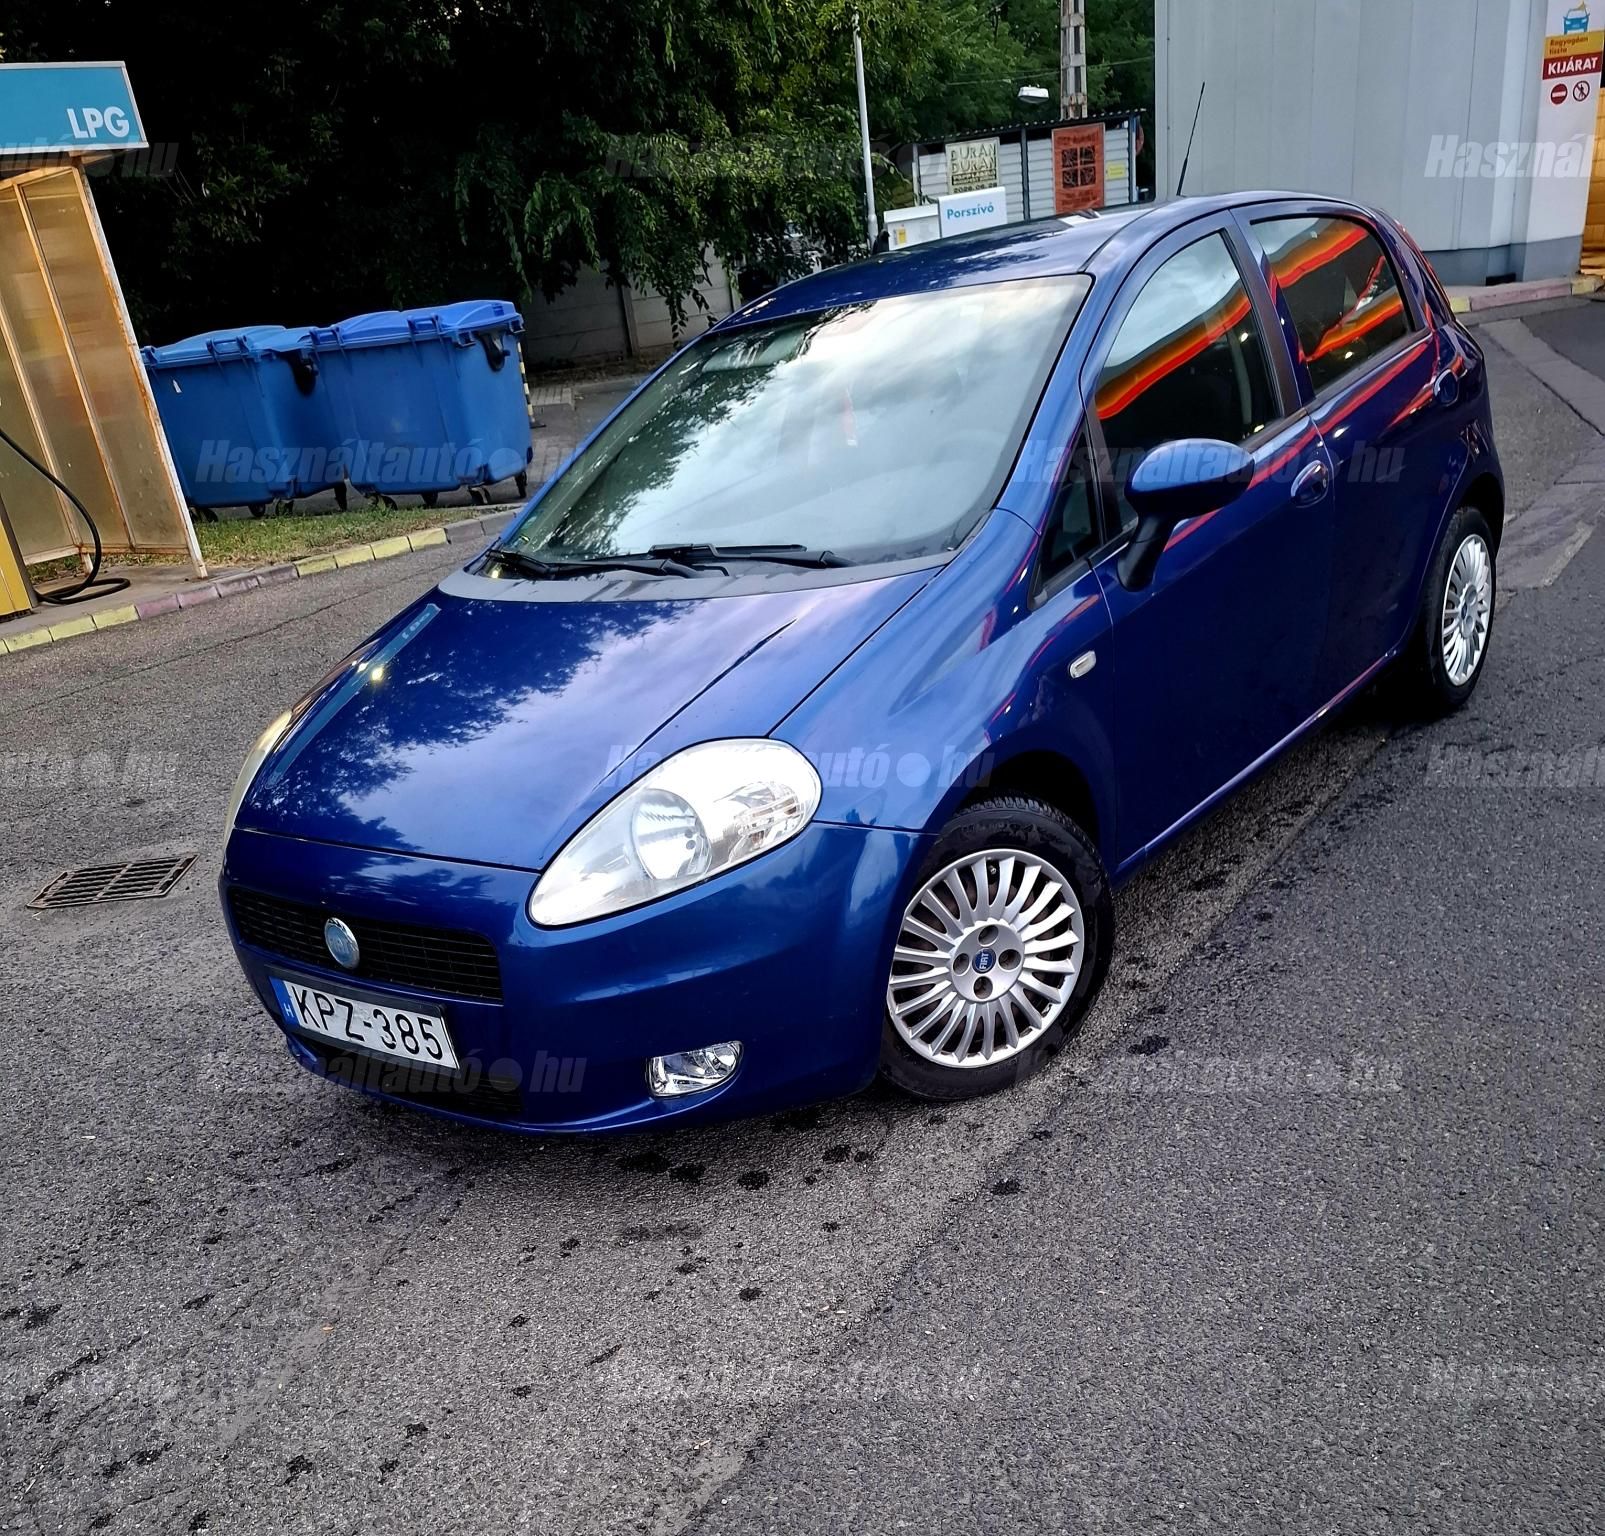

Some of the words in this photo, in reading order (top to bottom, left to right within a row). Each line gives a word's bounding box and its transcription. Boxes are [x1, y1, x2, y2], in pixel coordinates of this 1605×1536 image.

[1547, 56, 1598, 76] KIJÁRAT
[66, 106, 130, 139] LPG
[951, 143, 997, 161] DURAN
[951, 157, 997, 174] DURAN
[946, 203, 994, 220] Porszívó
[979, 952, 989, 970] FIAT
[283, 1003, 295, 1018] H
[291, 985, 443, 1061] KPZ-385
